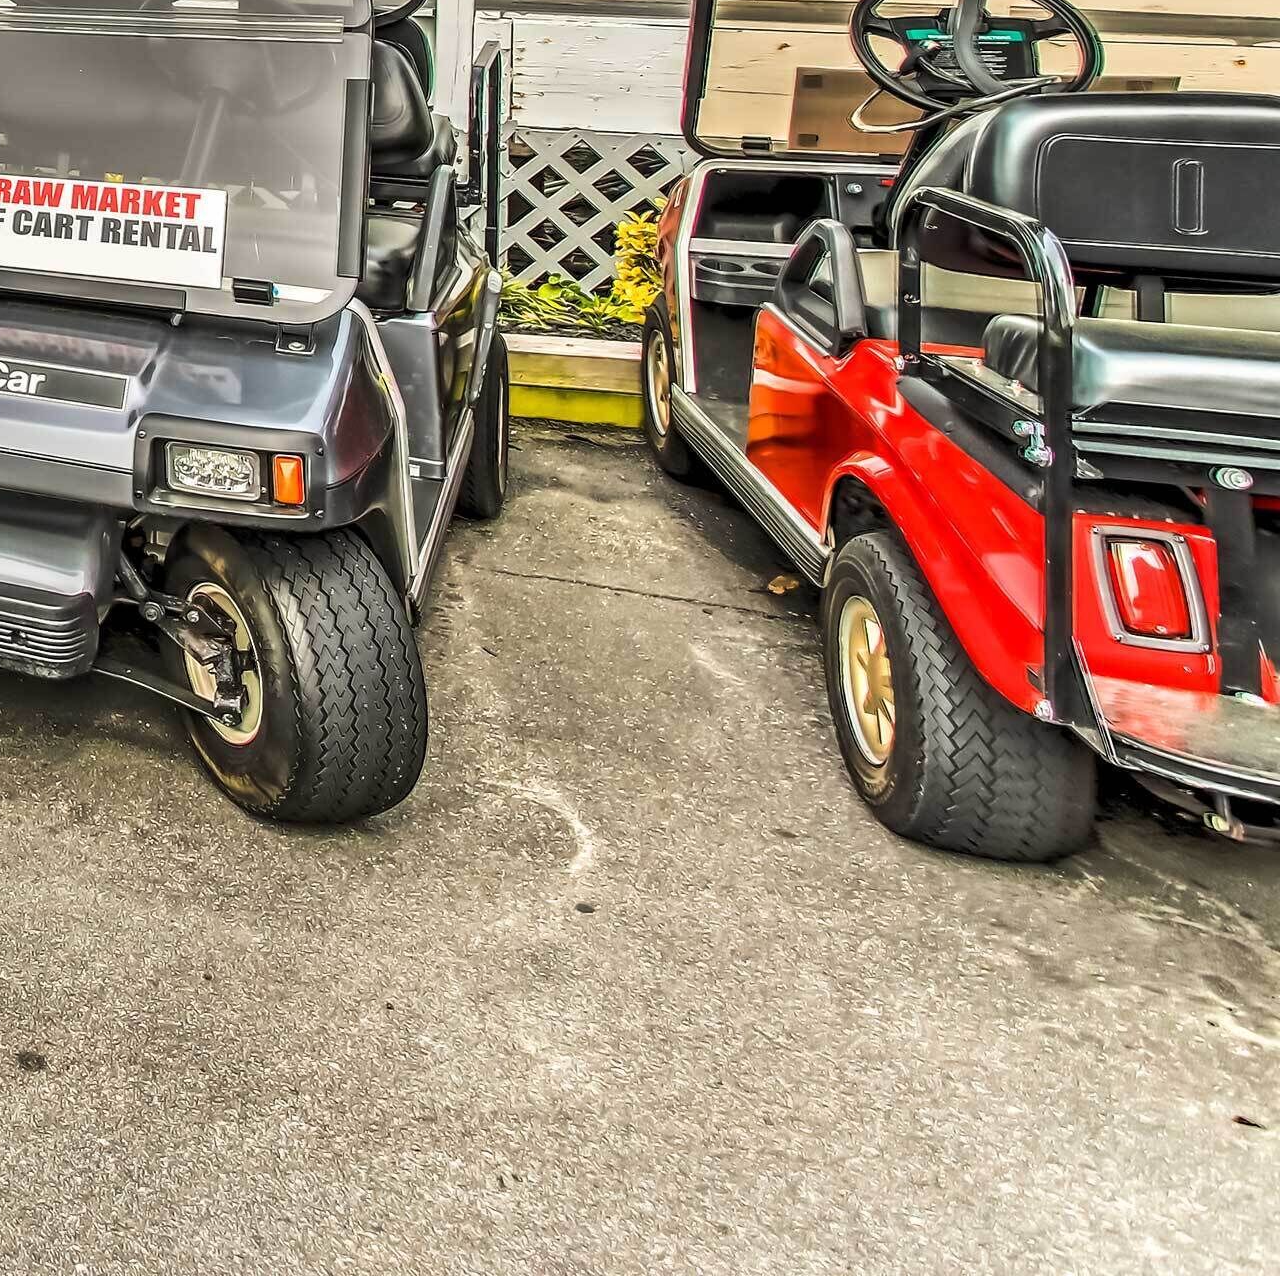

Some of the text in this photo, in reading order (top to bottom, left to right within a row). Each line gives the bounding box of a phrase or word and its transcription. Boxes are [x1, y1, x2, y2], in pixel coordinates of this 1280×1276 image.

[70, 185, 202, 219] MARKET
[18, 209, 95, 240] CART
[100, 217, 217, 254] RENTAL
